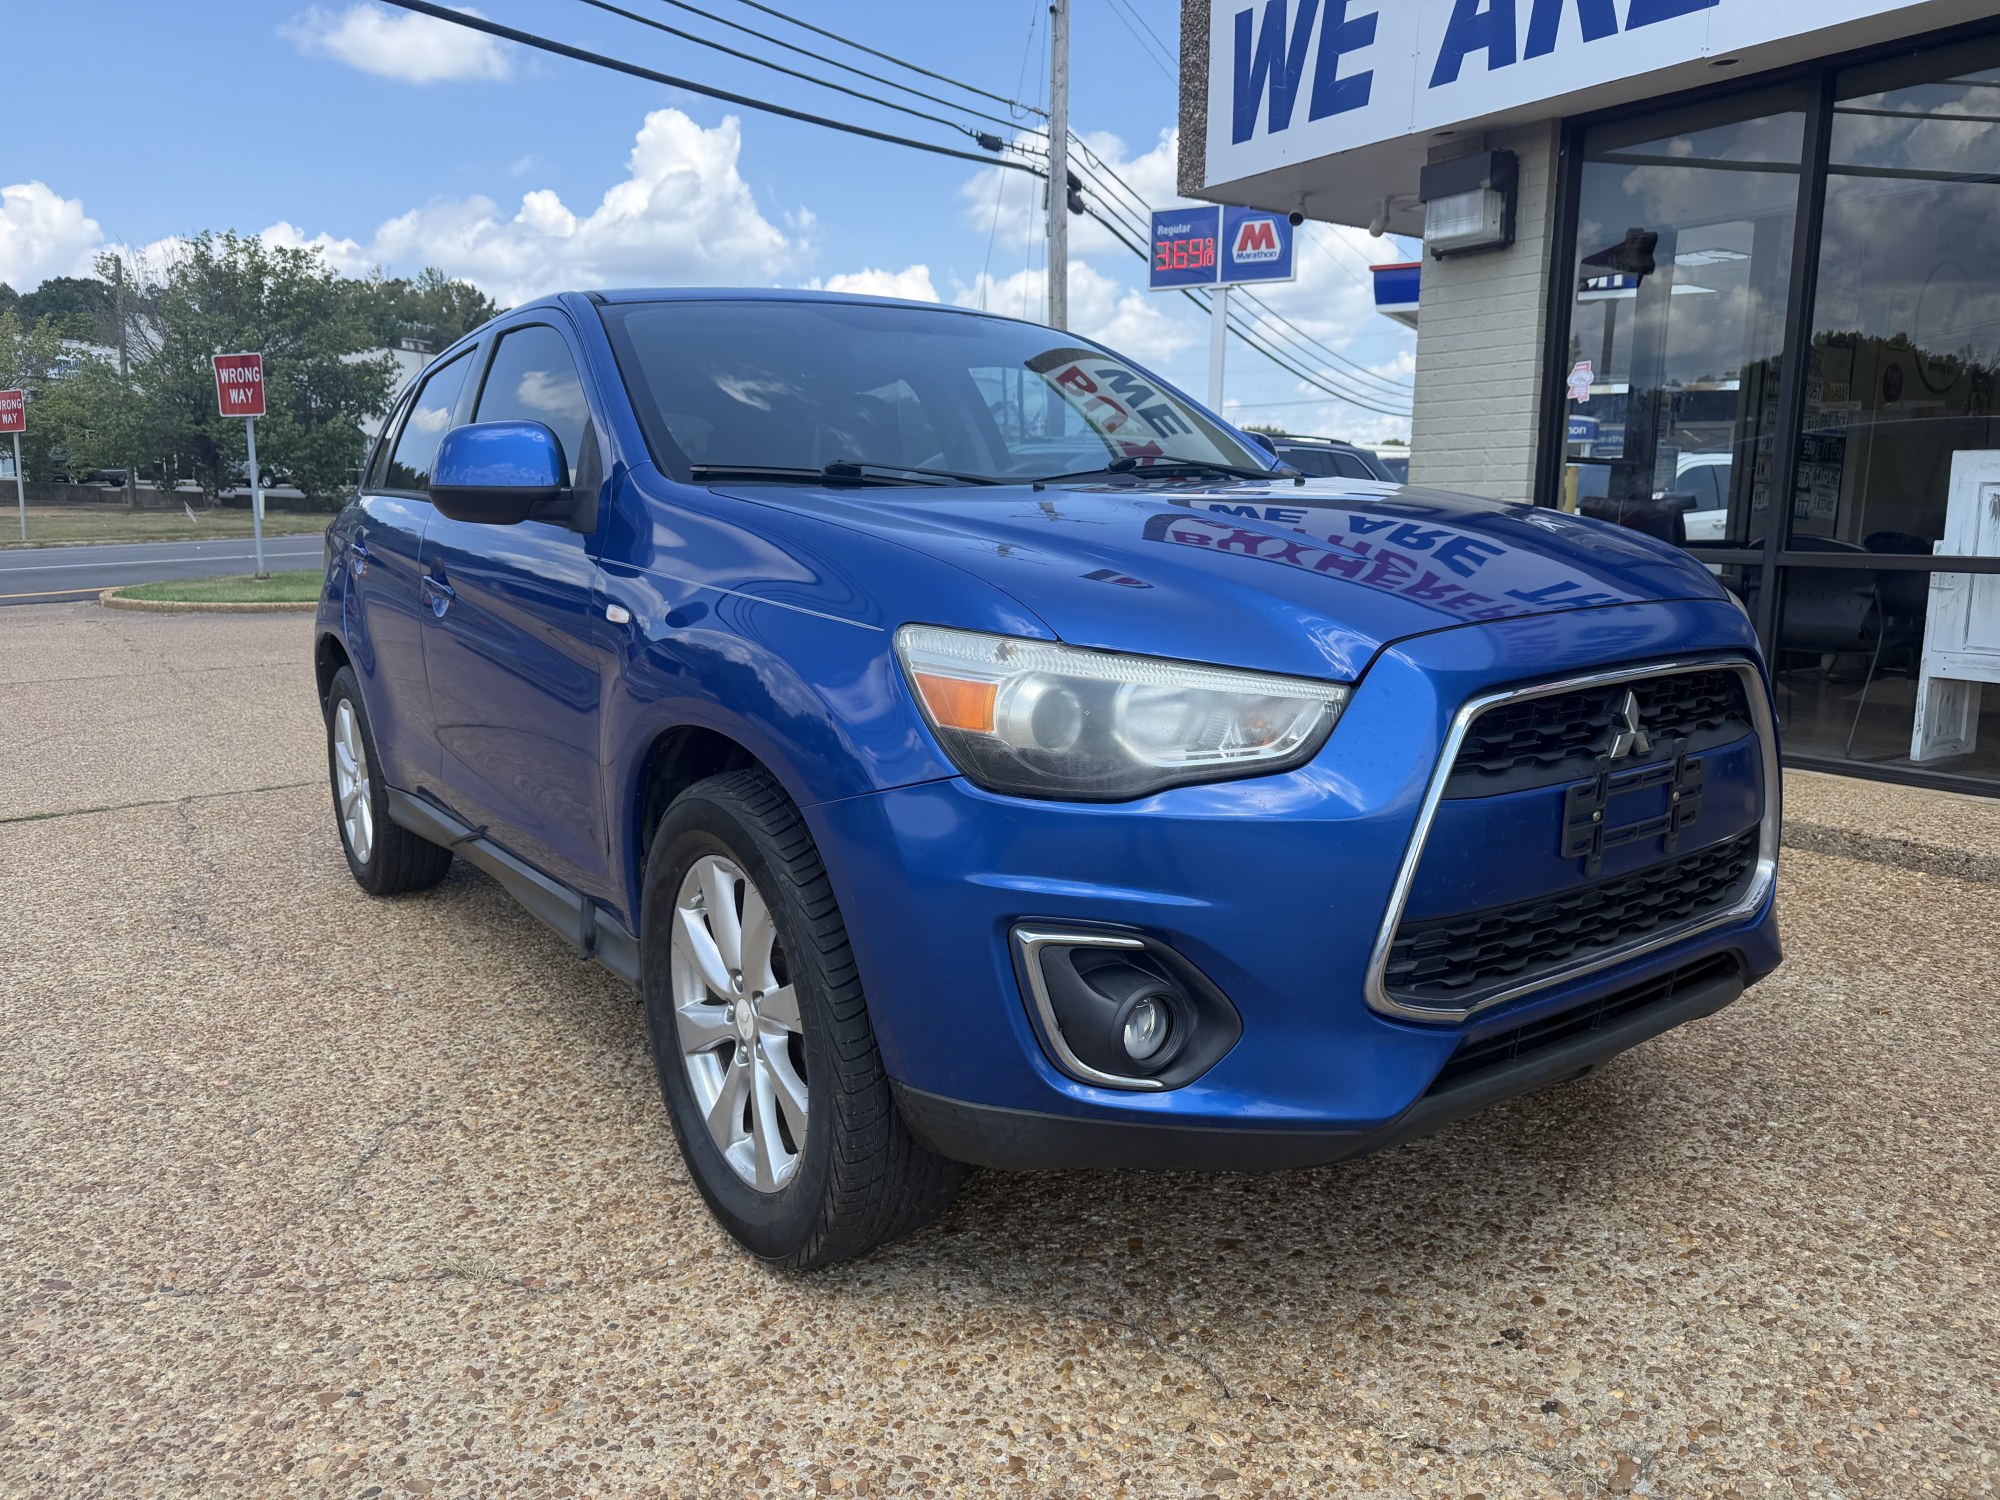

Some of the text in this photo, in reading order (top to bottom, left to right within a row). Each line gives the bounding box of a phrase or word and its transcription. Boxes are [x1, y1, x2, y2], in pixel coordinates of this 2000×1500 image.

[1232, 0, 1379, 145] WE
[1157, 224, 1191, 236] Regular
[1237, 222, 1276, 252] M
[1235, 250, 1277, 260] Marathon
[219, 366, 260, 384] WRONG
[229, 387, 253, 404] WAY
[0, 398, 22, 410] RONG
[1, 412, 18, 424] WAY
